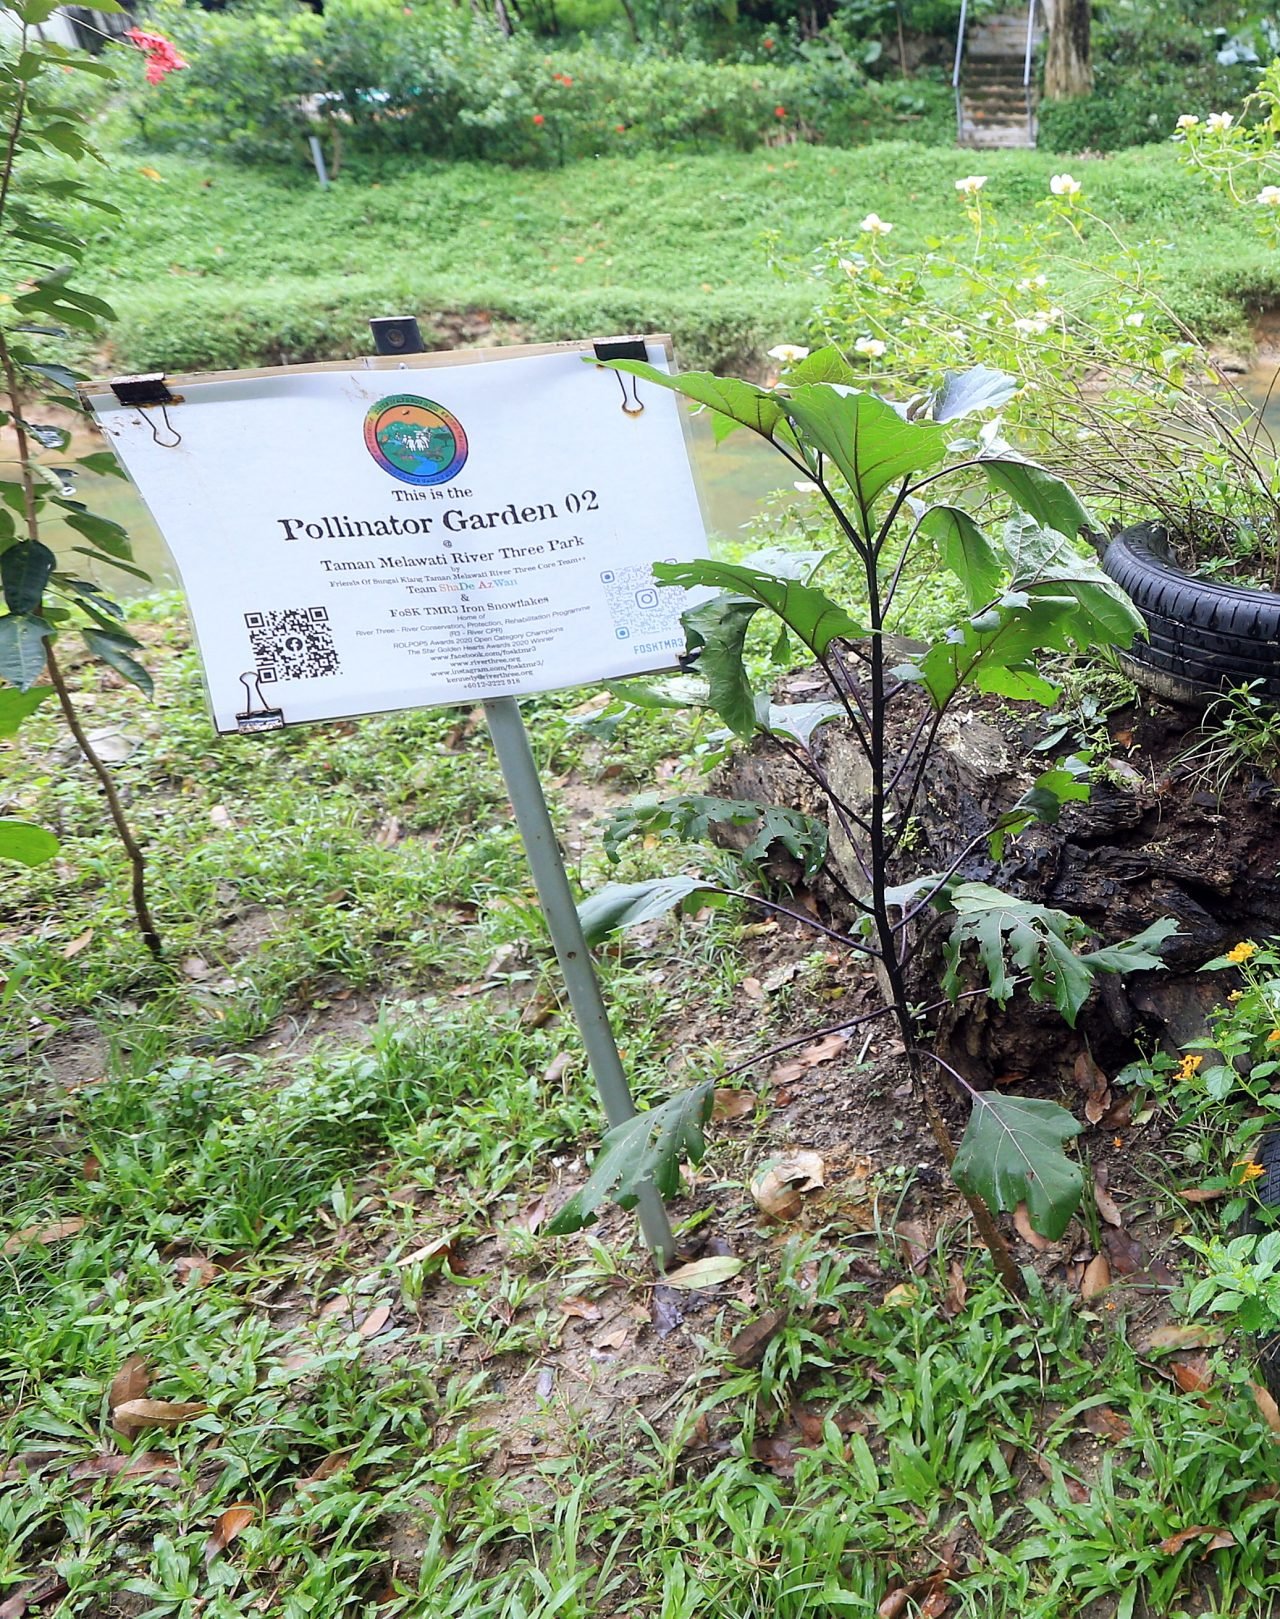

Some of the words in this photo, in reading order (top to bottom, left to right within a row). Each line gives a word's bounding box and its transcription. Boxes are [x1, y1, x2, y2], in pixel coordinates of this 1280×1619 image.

[392, 489, 426, 502] This
[430, 488, 443, 500] is
[448, 486, 474, 499] the
[277, 514, 433, 541] Pollinator
[442, 504, 558, 532] Garden
[565, 489, 600, 514] 02
[320, 559, 375, 572] Taman
[378, 554, 448, 569] Melawati
[451, 550, 494, 564] River
[498, 545, 545, 559] Three
[548, 536, 584, 552] Park
[513, 566, 536, 574] Three
[406, 586, 437, 594] Team
[389, 608, 421, 618] FoSK
[423, 606, 458, 616] TMR3
[461, 604, 486, 614] Iron
[487, 596, 550, 611] Snowflakes
